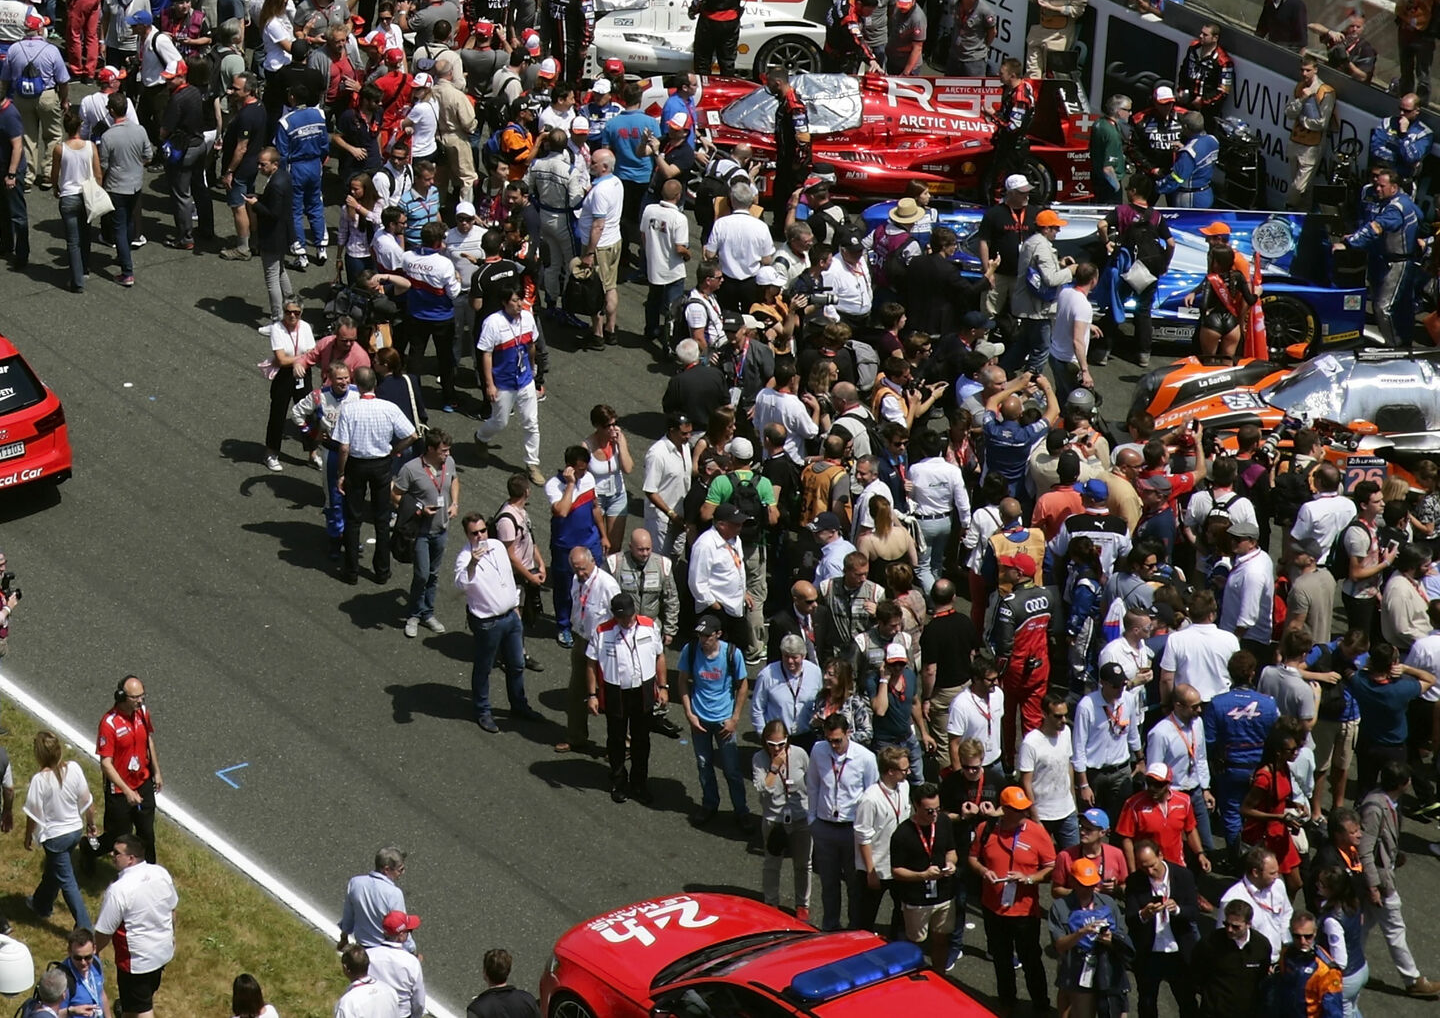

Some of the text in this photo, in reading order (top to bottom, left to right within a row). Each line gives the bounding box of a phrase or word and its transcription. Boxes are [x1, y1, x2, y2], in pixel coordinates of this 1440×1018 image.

[944, 86, 971, 94] ARCTIC
[899, 114, 996, 134] ARCTIC VELVET
[1149, 131, 1181, 142] ARCTIC
[407, 262, 433, 272] DENSO
[1198, 374, 1232, 388] La Sarthe
[4, 443, 23, 458] 1103
[20, 467, 44, 481] Car
